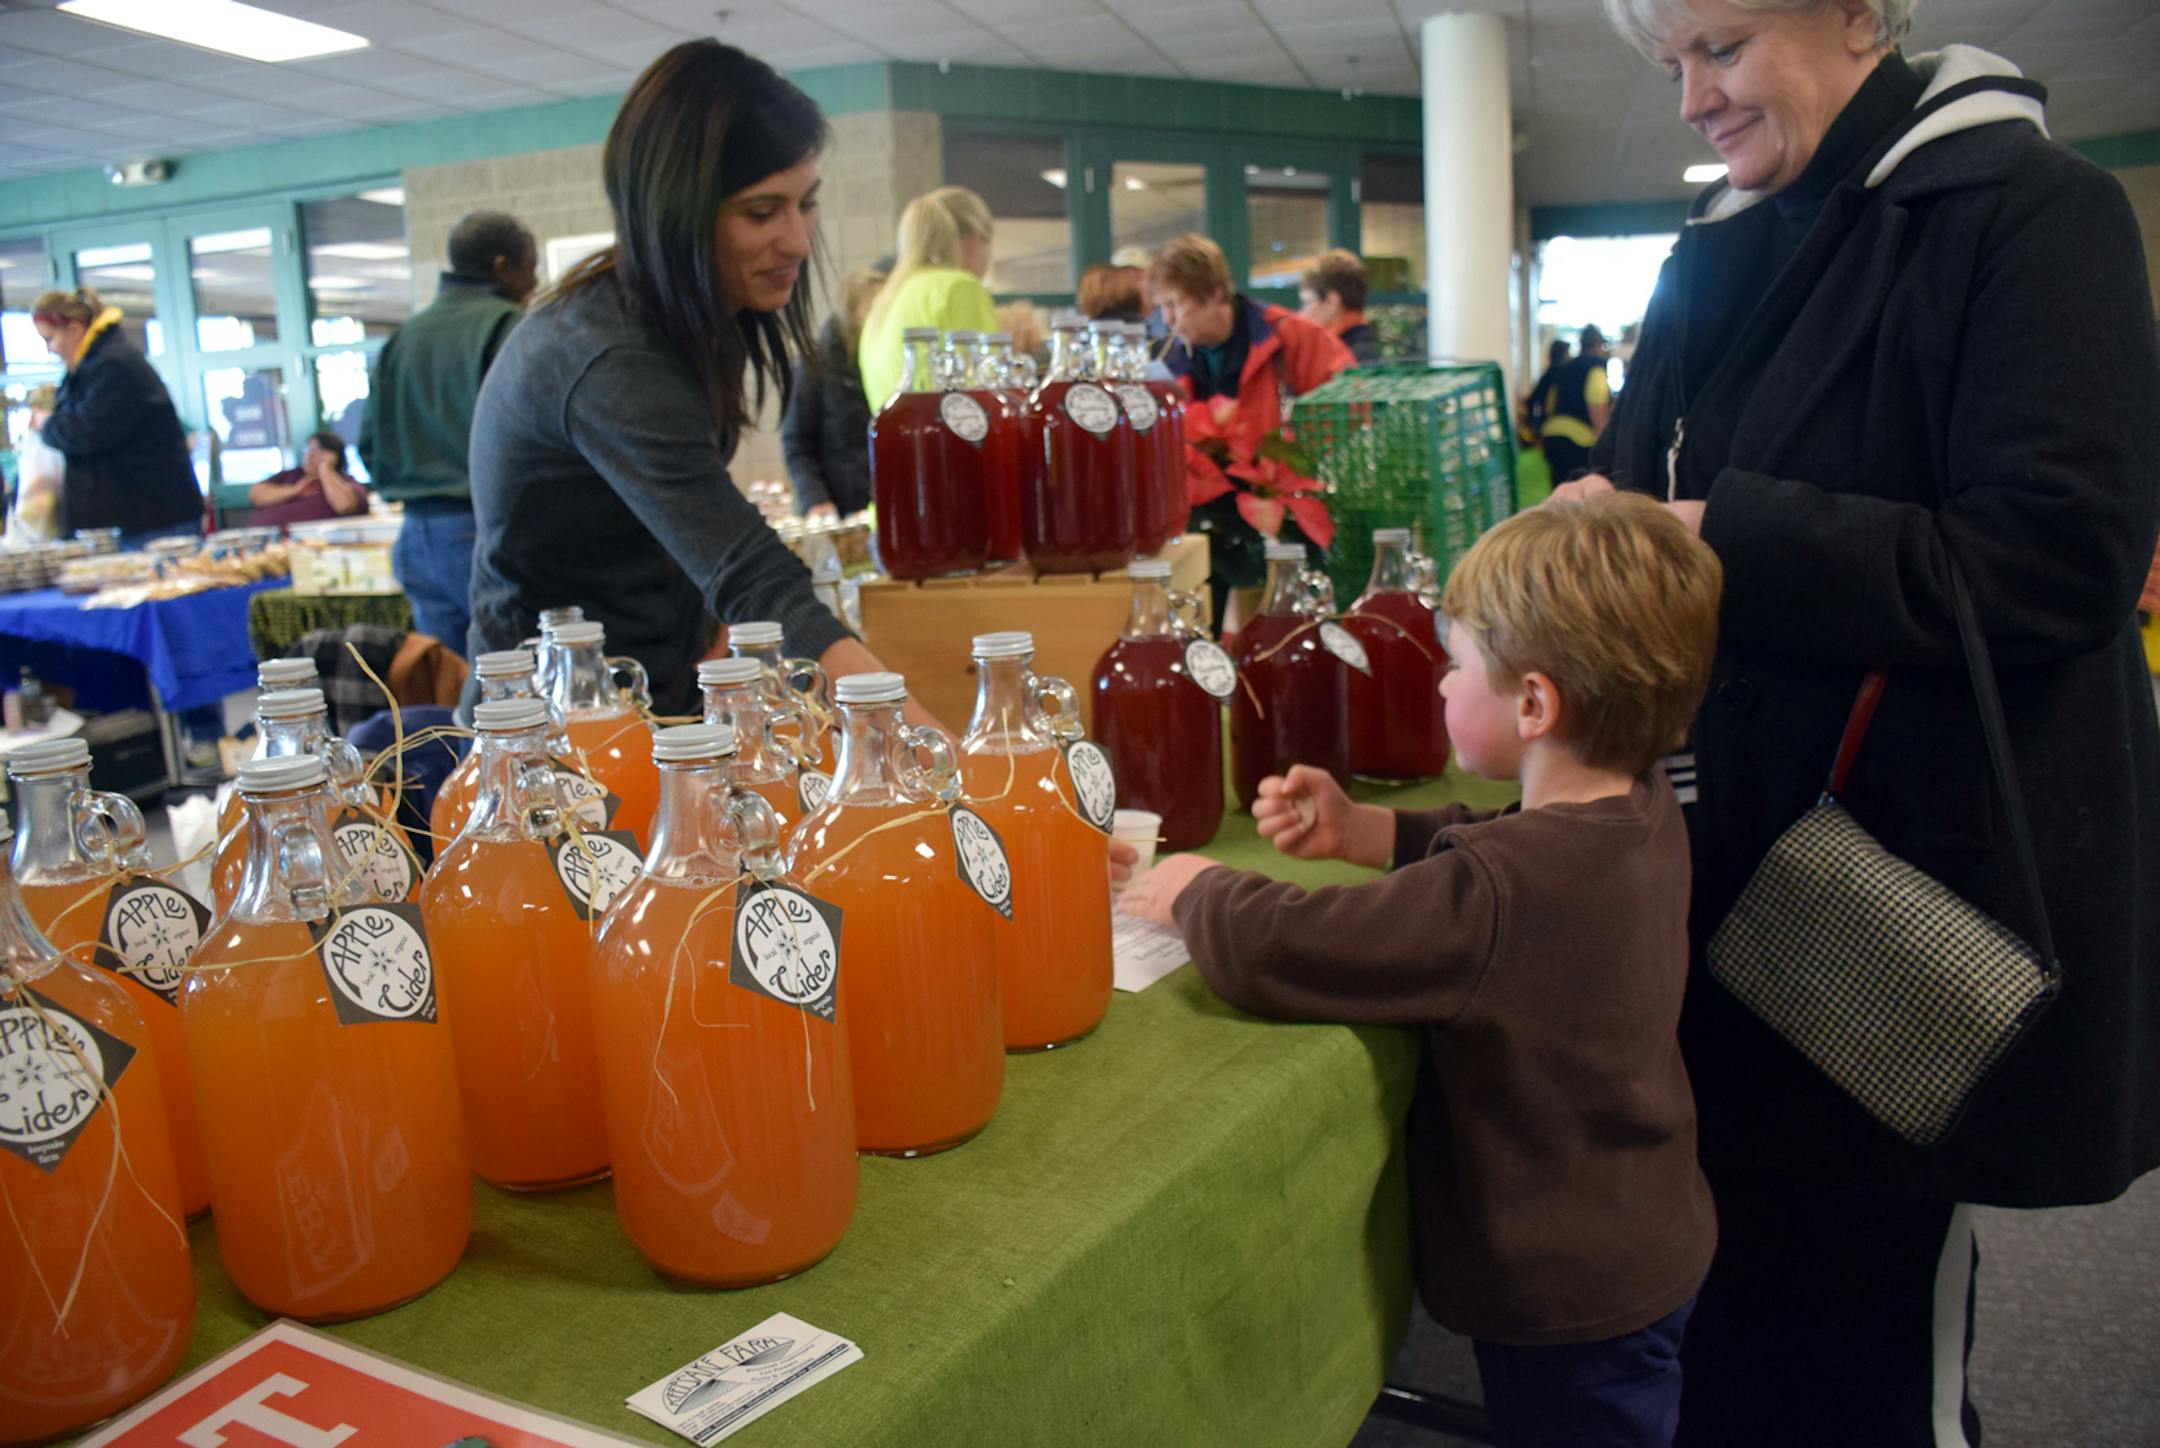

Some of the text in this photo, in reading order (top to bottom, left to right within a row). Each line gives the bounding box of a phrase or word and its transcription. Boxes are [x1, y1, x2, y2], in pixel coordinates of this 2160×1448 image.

[378, 950, 427, 1012] Cider
[769, 949, 831, 998] Cider
[722, 1338, 778, 1365] FARM
